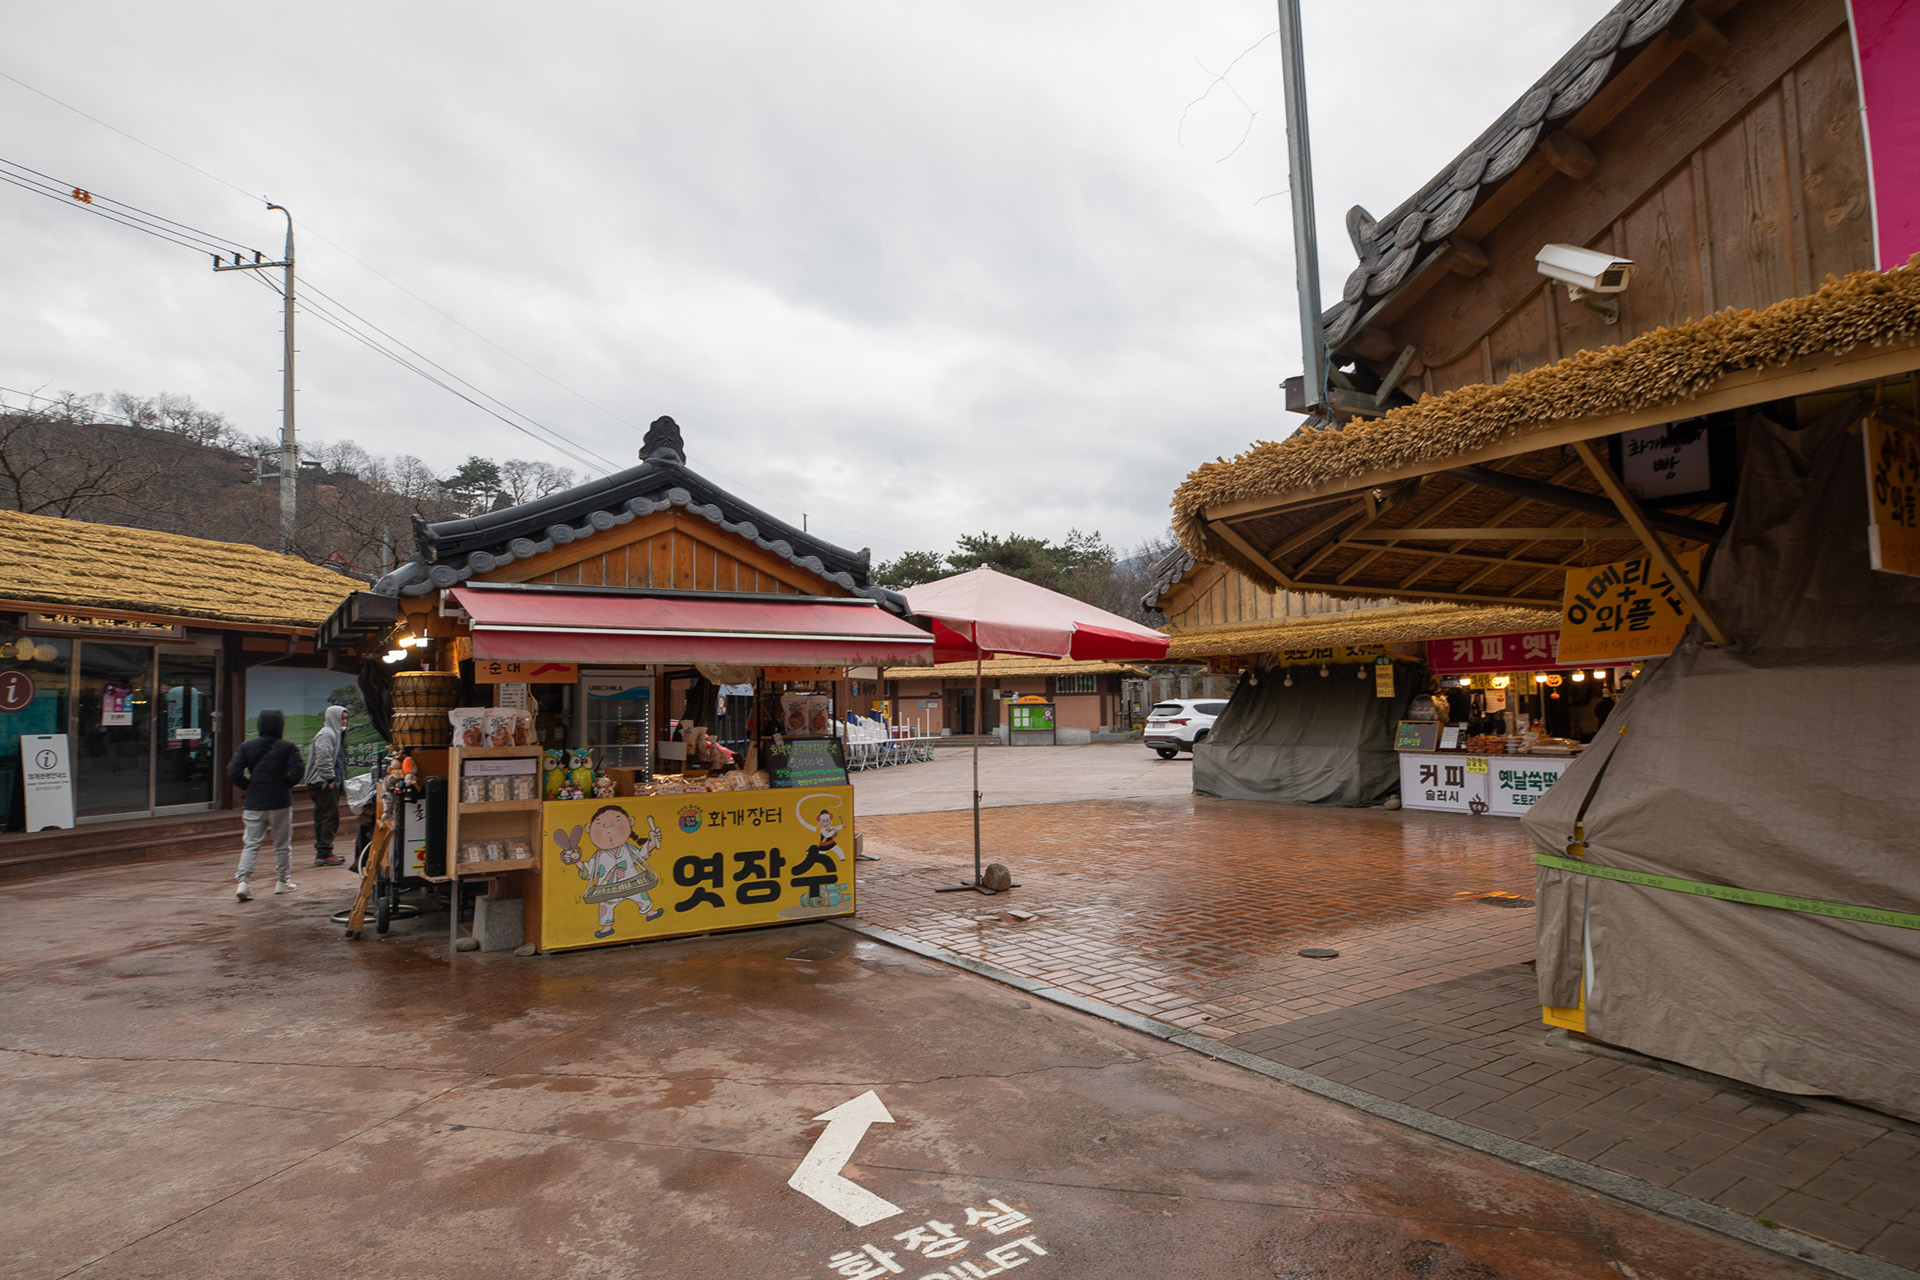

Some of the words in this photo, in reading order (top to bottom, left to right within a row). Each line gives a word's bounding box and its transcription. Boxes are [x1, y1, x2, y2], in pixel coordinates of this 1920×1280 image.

[1568, 558, 1684, 625] 아메리카
[1592, 598, 1656, 633] 와플
[1452, 637, 1504, 662] 커피
[1419, 764, 1465, 788] 커피
[1425, 789, 1459, 803] 슬러시
[708, 807, 782, 828] 화개장터
[673, 845, 838, 912] 엿장수
[828, 1198, 1034, 1280] 화장실
